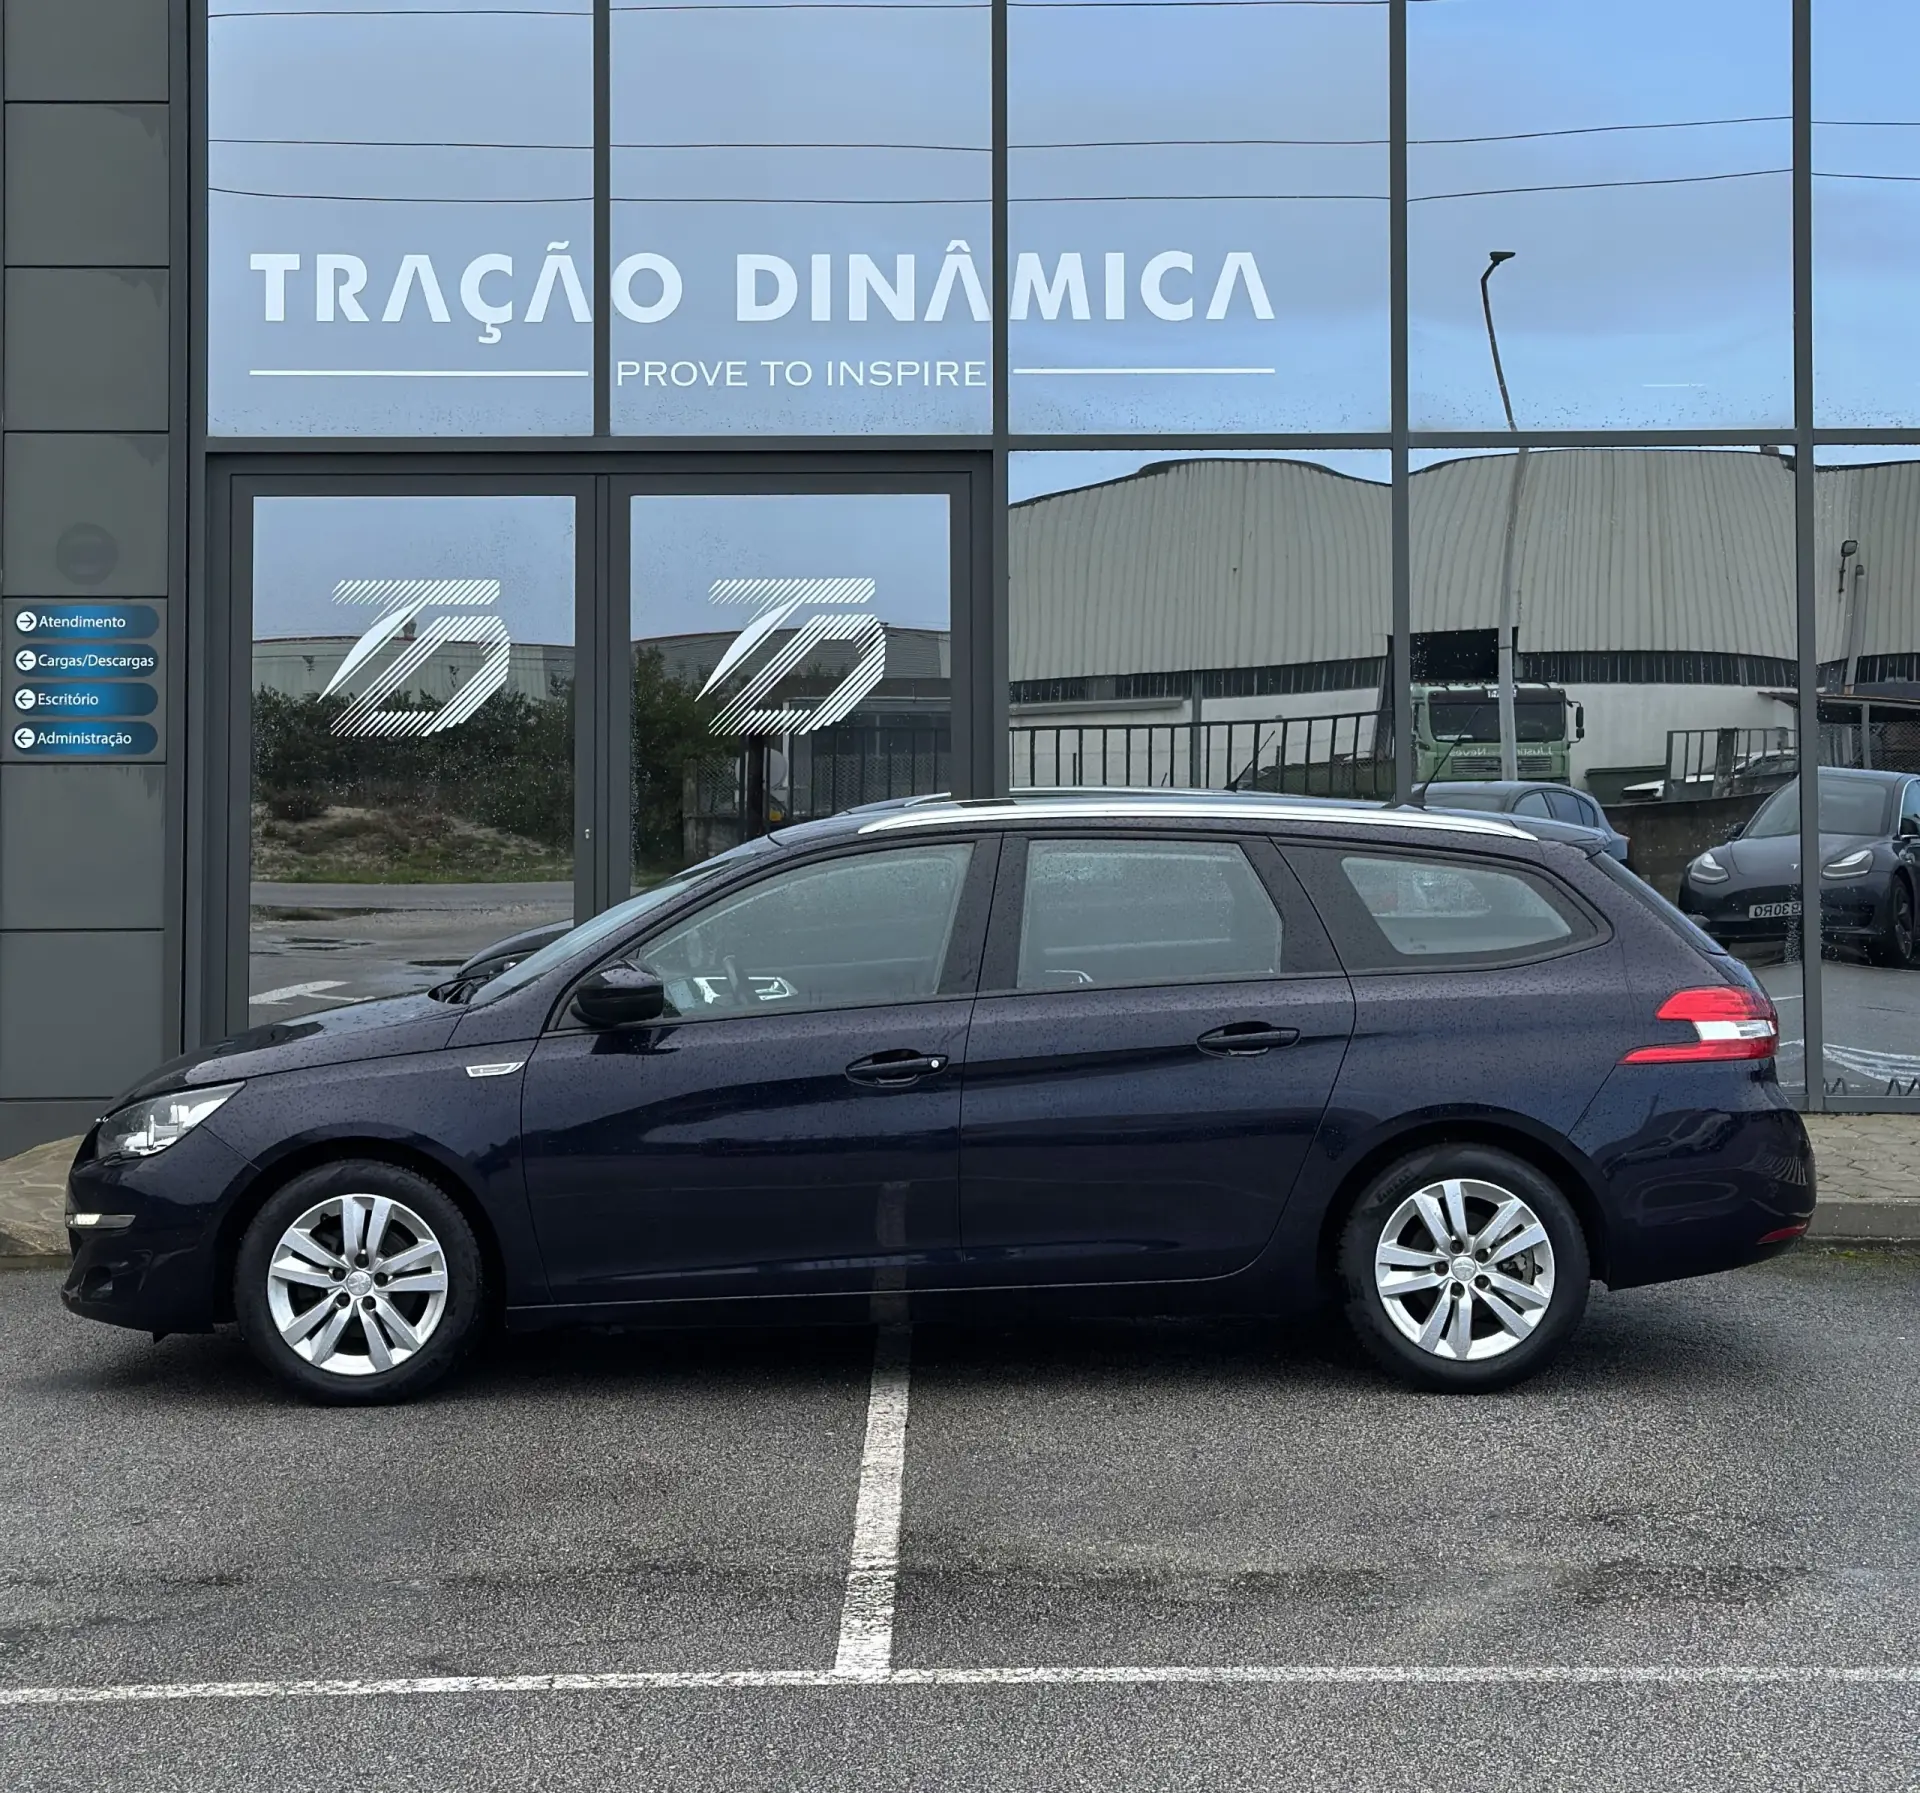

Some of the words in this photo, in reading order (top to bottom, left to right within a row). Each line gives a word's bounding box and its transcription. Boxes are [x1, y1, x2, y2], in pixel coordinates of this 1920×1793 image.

[249, 240, 683, 344] TRAÇÃO
[736, 239, 1275, 322] DINÂMICA
[616, 360, 748, 387] PROVE
[760, 360, 813, 387] TO
[826, 360, 987, 387] INSPIRE
[38, 615, 127, 628] Atendimento
[37, 654, 155, 670] Cargas/Descargas
[37, 693, 99, 706] Escritório
[36, 732, 132, 747] Administração
